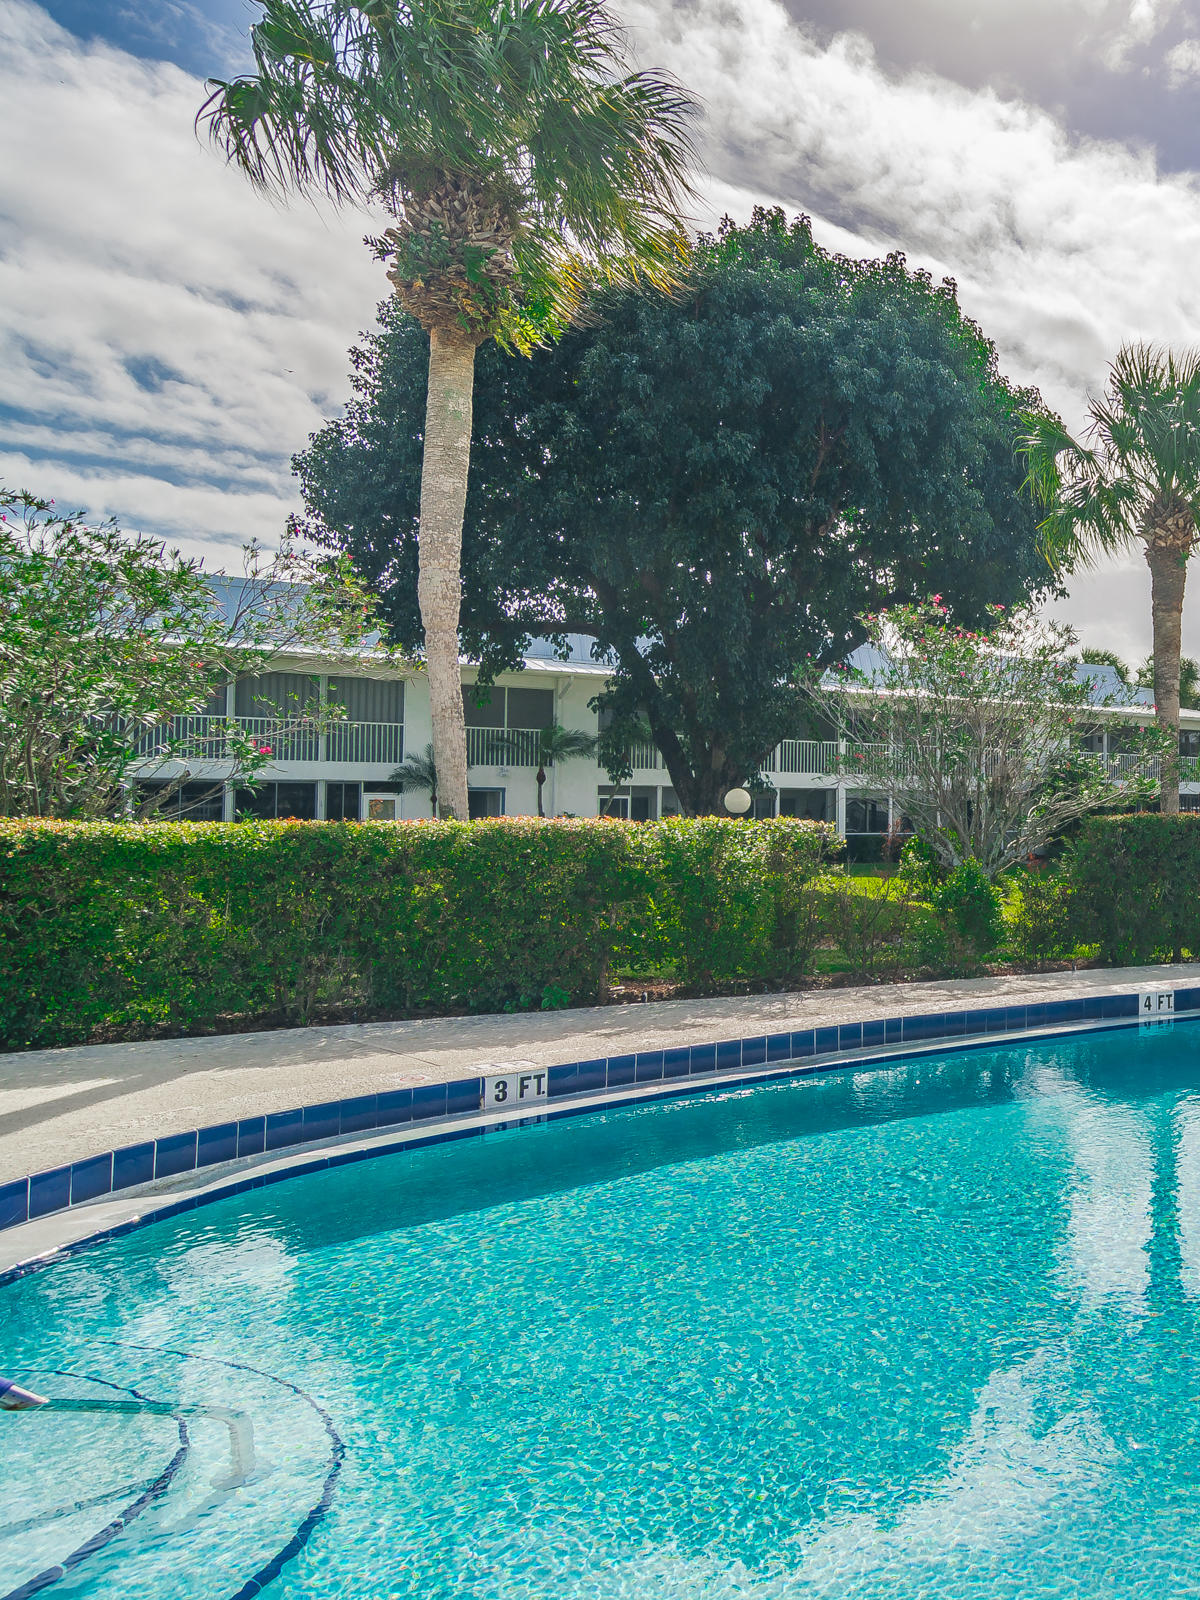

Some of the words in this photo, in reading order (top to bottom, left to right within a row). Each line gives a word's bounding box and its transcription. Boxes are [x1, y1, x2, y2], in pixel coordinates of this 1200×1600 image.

[1143, 995, 1152, 1011] 4
[494, 1080, 508, 1102] 3
[519, 1073, 546, 1099] FT.
